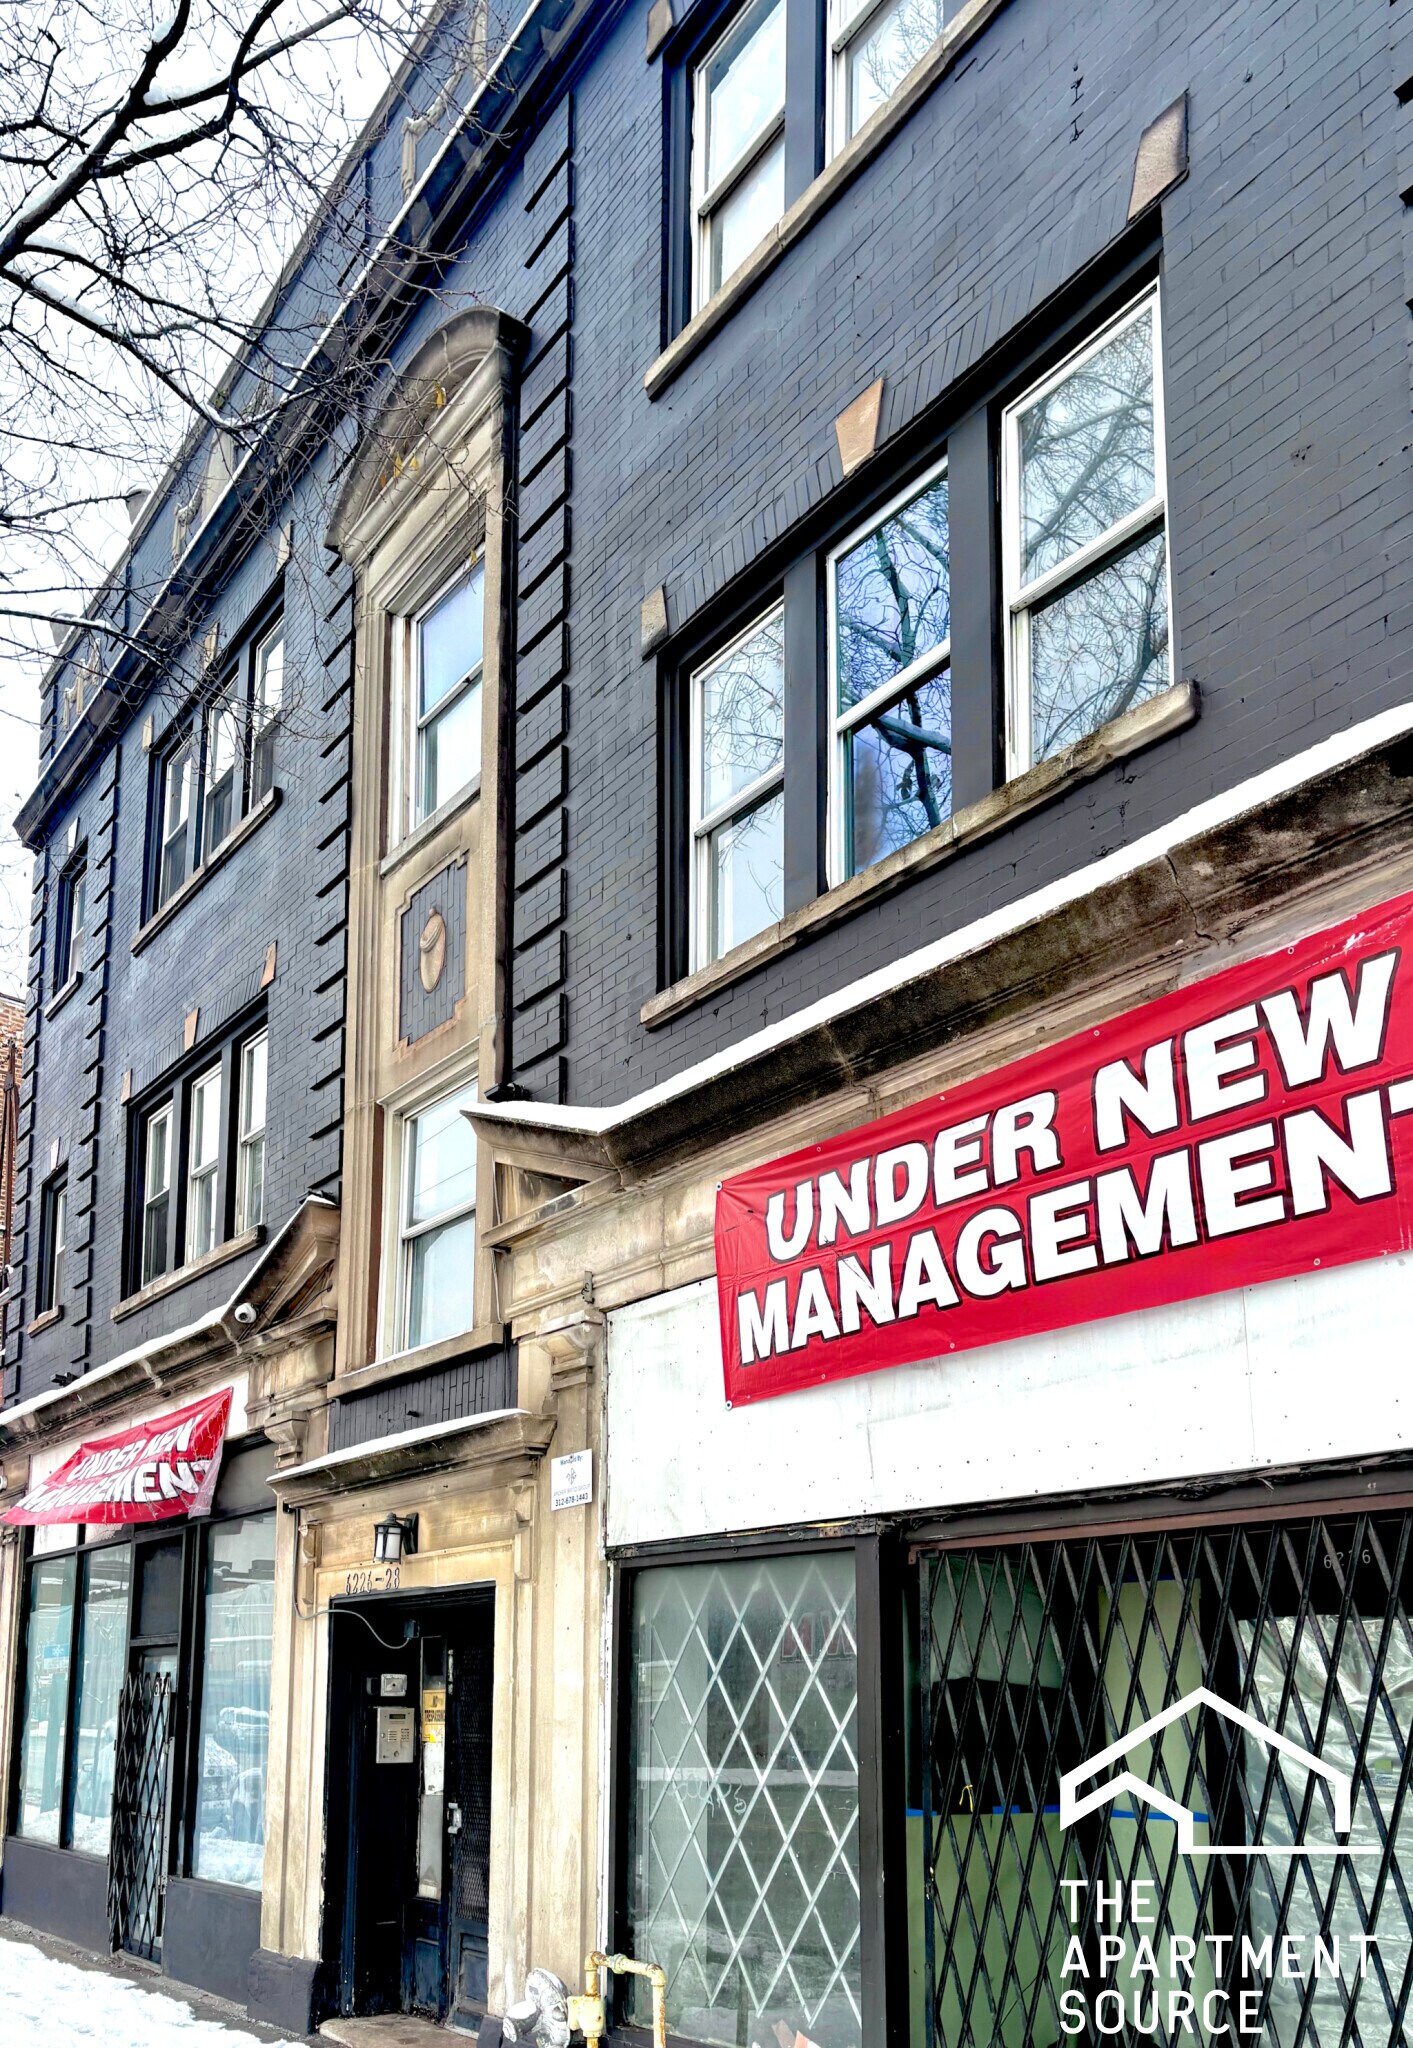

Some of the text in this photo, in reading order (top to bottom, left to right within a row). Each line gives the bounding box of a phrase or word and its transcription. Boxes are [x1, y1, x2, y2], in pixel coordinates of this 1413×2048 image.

[765, 949, 1401, 1264] UNDER NEW
[66, 1437, 148, 1483] UNDER
